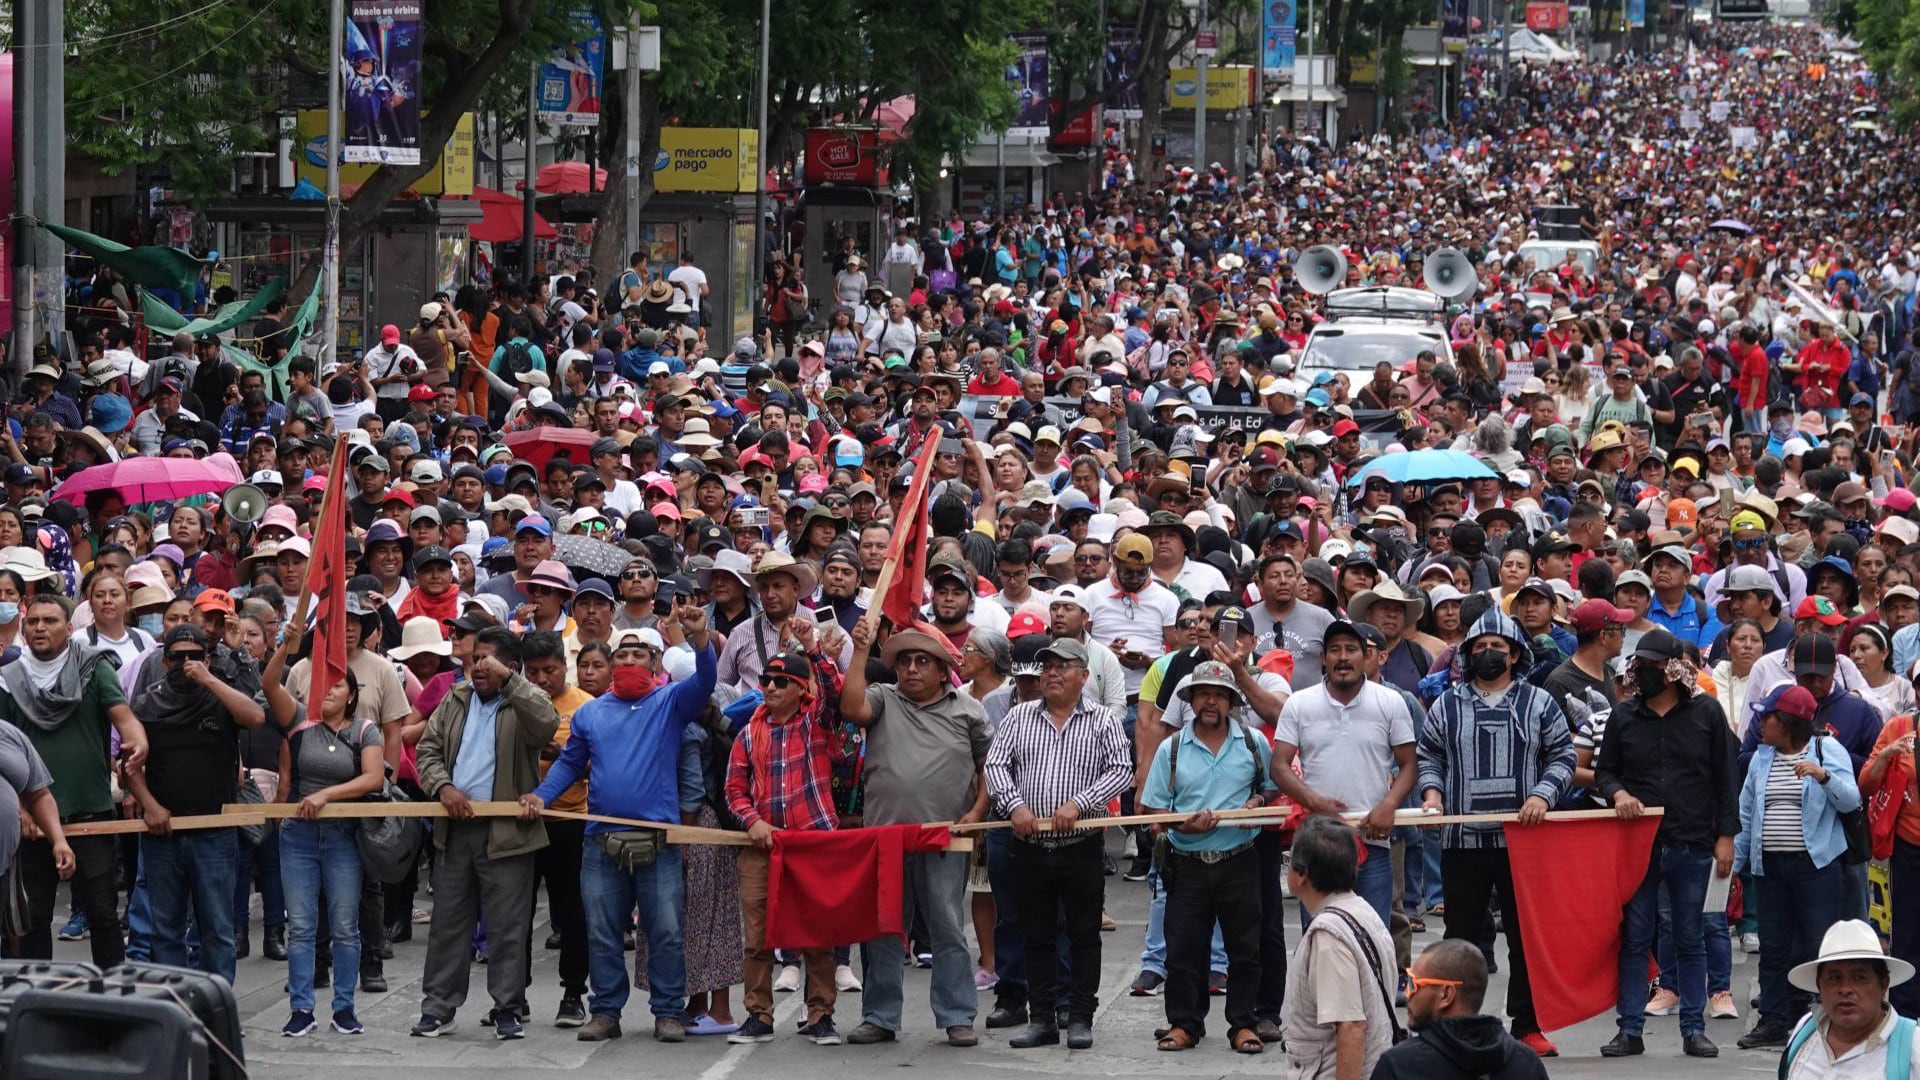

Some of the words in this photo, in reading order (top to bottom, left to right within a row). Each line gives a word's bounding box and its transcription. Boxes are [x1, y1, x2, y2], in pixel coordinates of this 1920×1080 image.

[353, 6, 381, 16] Abuelo
[394, 5, 420, 15] órbita
[674, 146, 733, 159] mercado
[830, 145, 848, 153] HOT
[674, 159, 708, 172] pago
[1209, 415, 1226, 427] de
[1230, 415, 1242, 428] la
